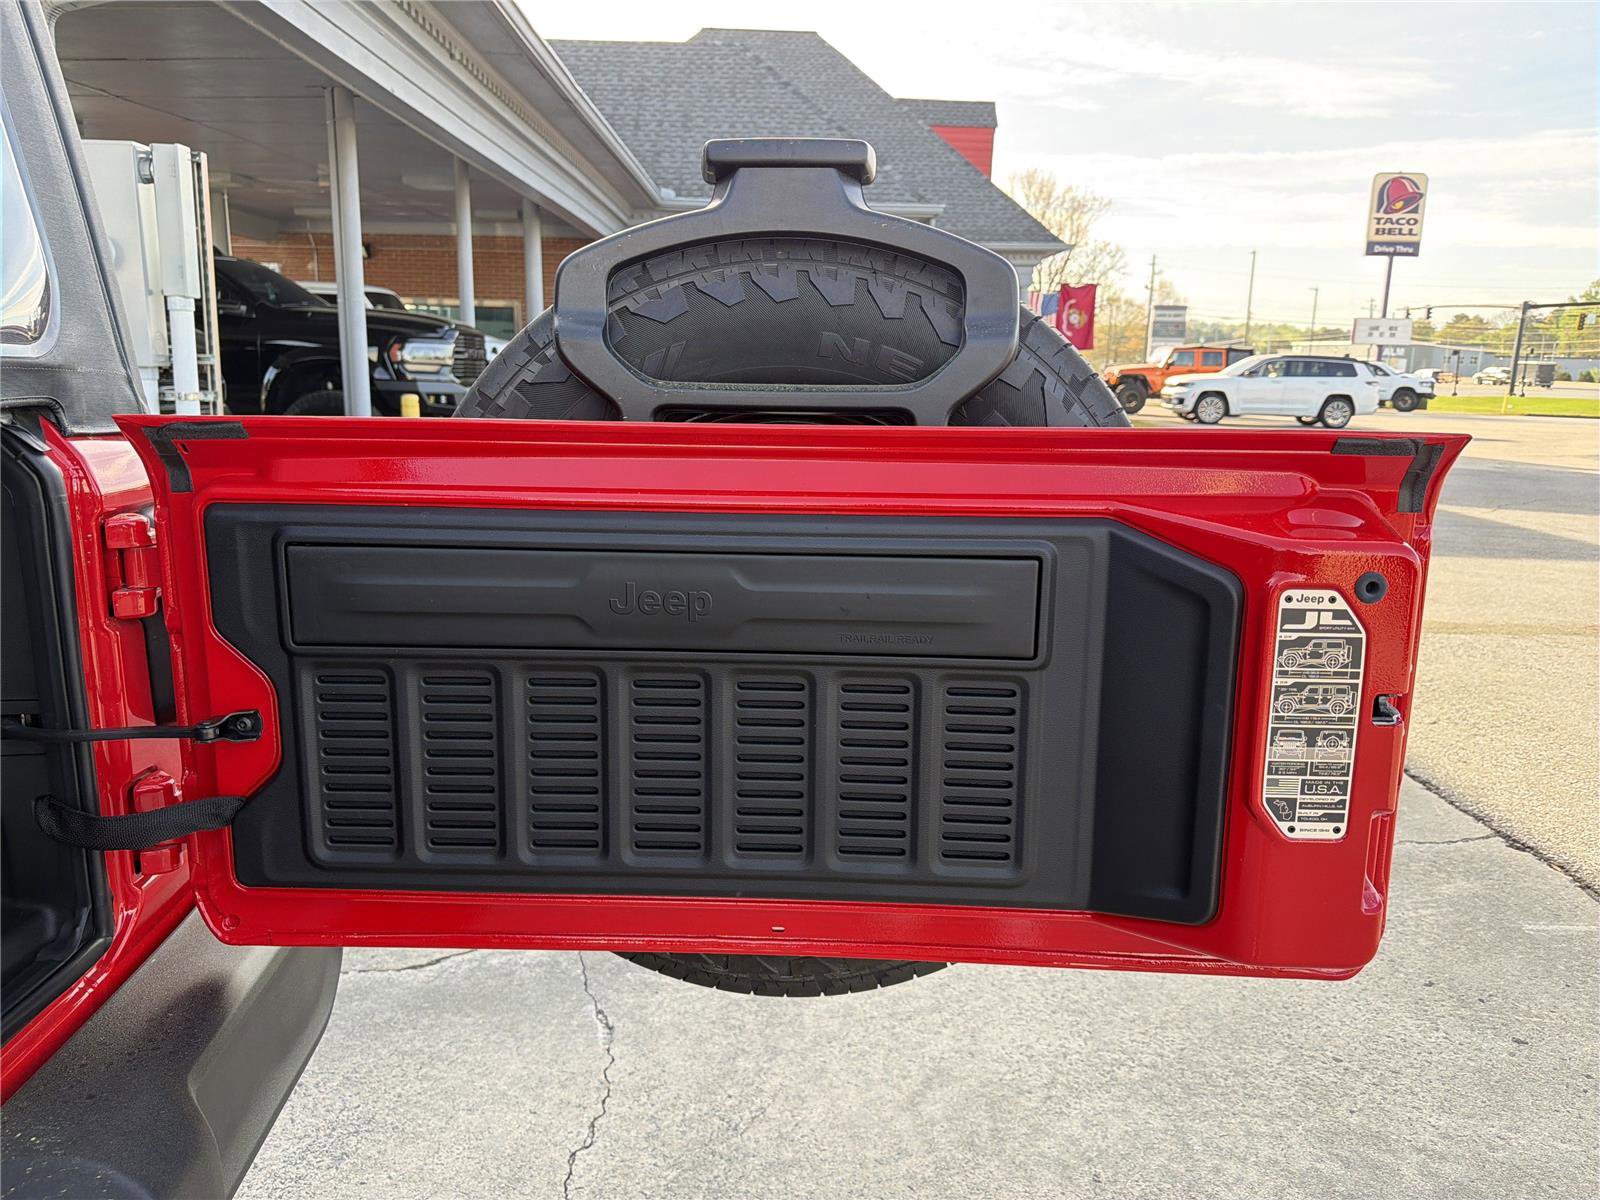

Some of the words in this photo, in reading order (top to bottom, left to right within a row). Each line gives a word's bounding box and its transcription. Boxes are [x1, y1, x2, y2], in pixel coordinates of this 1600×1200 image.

[1373, 217, 1419, 226] TACO
[1374, 228, 1418, 236] BELL
[1374, 245, 1395, 253] Drive
[1396, 245, 1414, 253] Thru
[609, 581, 713, 624] Jeep
[1296, 594, 1325, 605] Jeep
[1281, 611, 1353, 630] JL
[1304, 785, 1343, 794] U.S.A.
